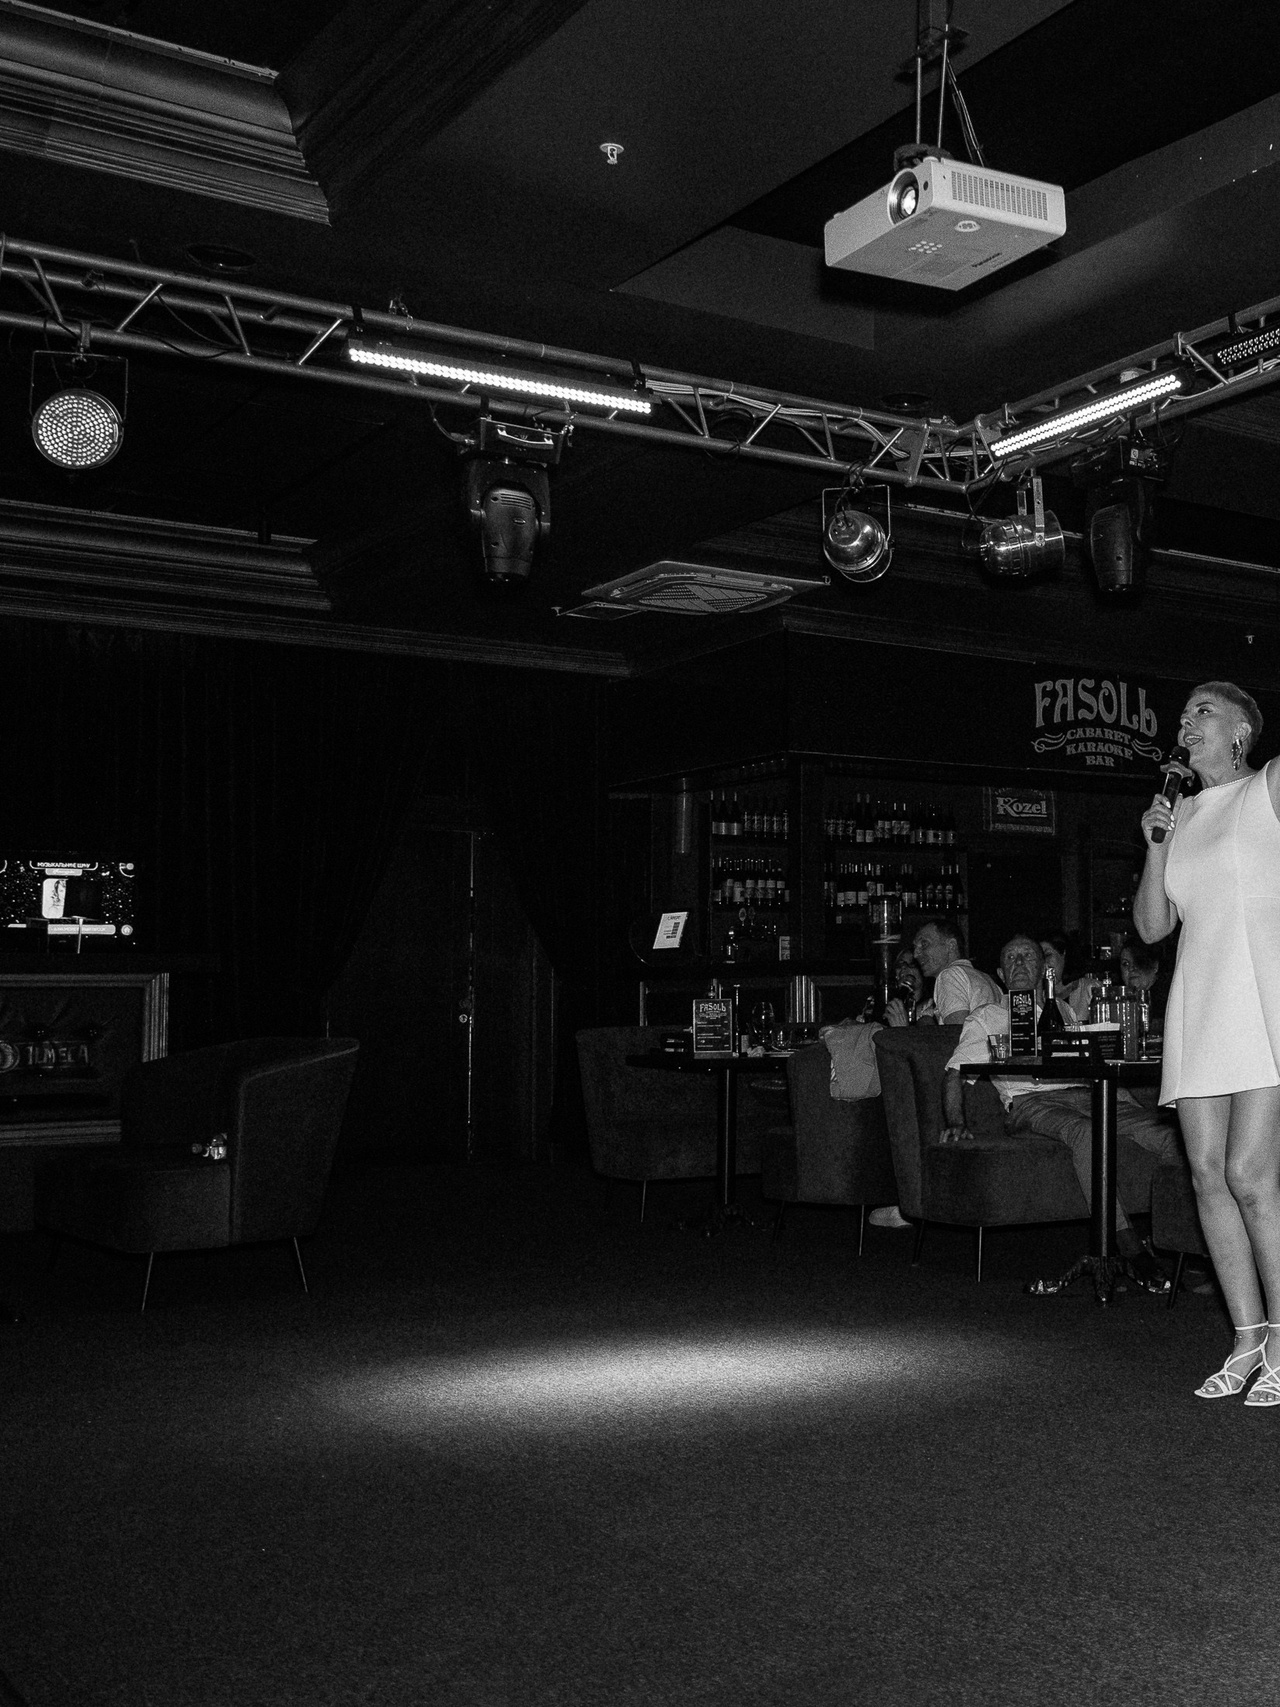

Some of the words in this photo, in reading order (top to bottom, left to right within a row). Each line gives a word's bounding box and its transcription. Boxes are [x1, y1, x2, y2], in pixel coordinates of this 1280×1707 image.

[1066, 727, 1131, 745] CABARET
[1065, 742, 1133, 760] KARAOKE
[1085, 755, 1115, 767] BAR
[996, 796, 1048, 818] Kozel
